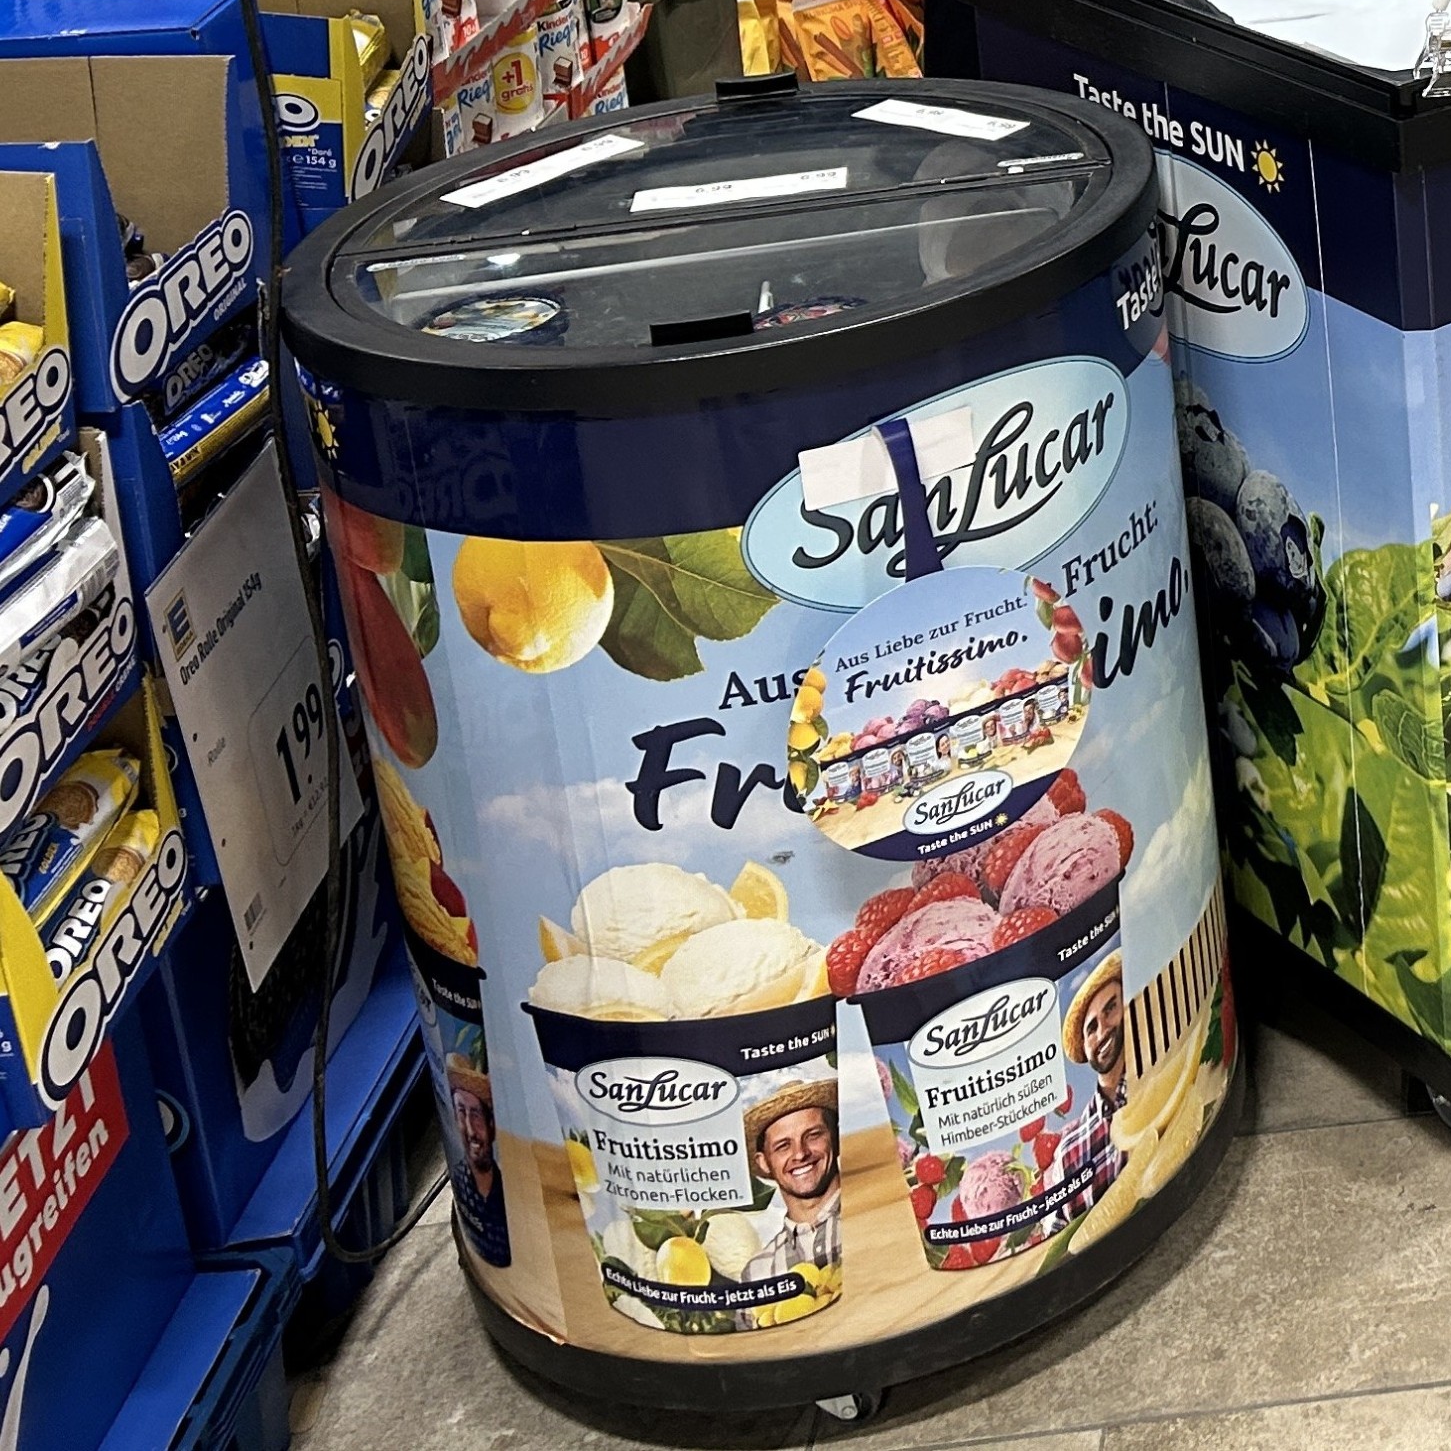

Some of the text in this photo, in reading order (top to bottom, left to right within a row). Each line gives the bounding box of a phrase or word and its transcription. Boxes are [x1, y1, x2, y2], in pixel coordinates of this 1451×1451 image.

[501, 83, 534, 103] gratis
[502, 60, 523, 86] +1
[354, 38, 428, 200] OREO
[1142, 103, 1184, 148] the
[1191, 121, 1245, 172] SUN
[1152, 202, 1290, 318] Lucar
[117, 215, 252, 387] OREO
[213, 277, 248, 322] ORIGINAL
[180, 658, 199, 685] Oreo
[197, 632, 219, 664] Rolle
[217, 593, 244, 638] Original
[836, 595, 1028, 673] Aus Liebe zur Frucht.
[844, 629, 1029, 704] Fruitissimo.
[0, 602, 134, 824] OREO
[914, 777, 1007, 825] SanLucar
[917, 819, 993, 857] Taste the SUN
[47, 880, 110, 985] OREO
[1057, 922, 1104, 962] Taste the
[40, 833, 185, 1101] OREO
[740, 1027, 830, 1061] Taste the SUN
[925, 985, 1050, 1057] SanLucar
[588, 1070, 728, 1112] SanLucar
[925, 1042, 1059, 1110] Fruitissimo
[939, 1073, 1054, 1128] Mit natürlich süßen
[593, 1128, 740, 1159] Fruitissimo
[940, 1090, 1059, 1146] Himbeer-Stückchen.
[604, 1178, 744, 1203] Zitronen-Flocken.
[607, 1162, 731, 1186] Mit natürlichen
[930, 1167, 1094, 1241] Echte Liebe zur Frucht jetzt als Eis
[606, 1268, 797, 1305] Echte Liebe zur Frucht jetzt als Eis
